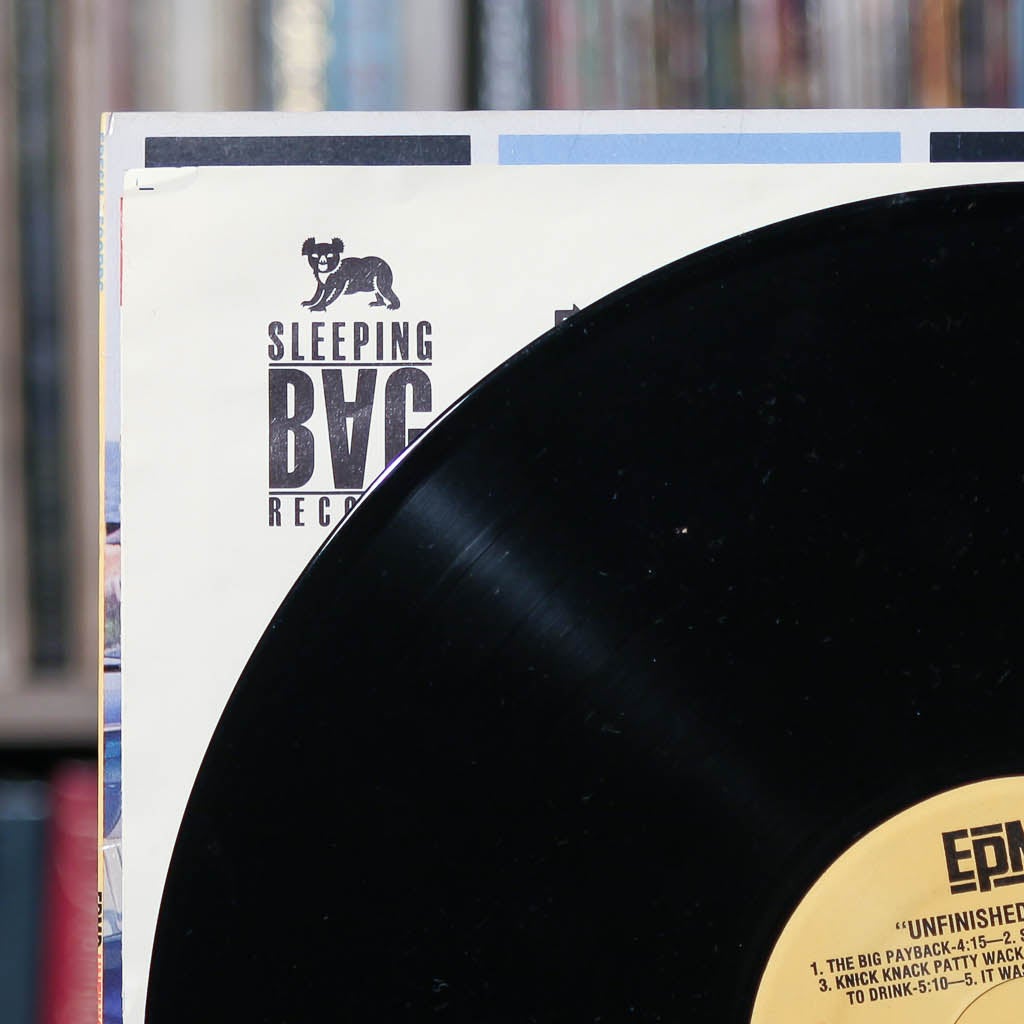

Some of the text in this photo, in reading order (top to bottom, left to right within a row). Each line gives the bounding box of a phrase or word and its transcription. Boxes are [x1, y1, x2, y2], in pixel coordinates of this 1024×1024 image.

[268, 320, 432, 361] SLEEPING
[809, 961, 823, 976] 1.
[825, 955, 855, 973] THE
[857, 951, 882, 968] BIG
[818, 977, 832, 992] 3.
[834, 968, 879, 990] KNICK
[881, 961, 931, 982] KNACK
[933, 953, 978, 974] PATTY
[845, 989, 864, 1005] TO
[980, 967, 994, 984] IT
